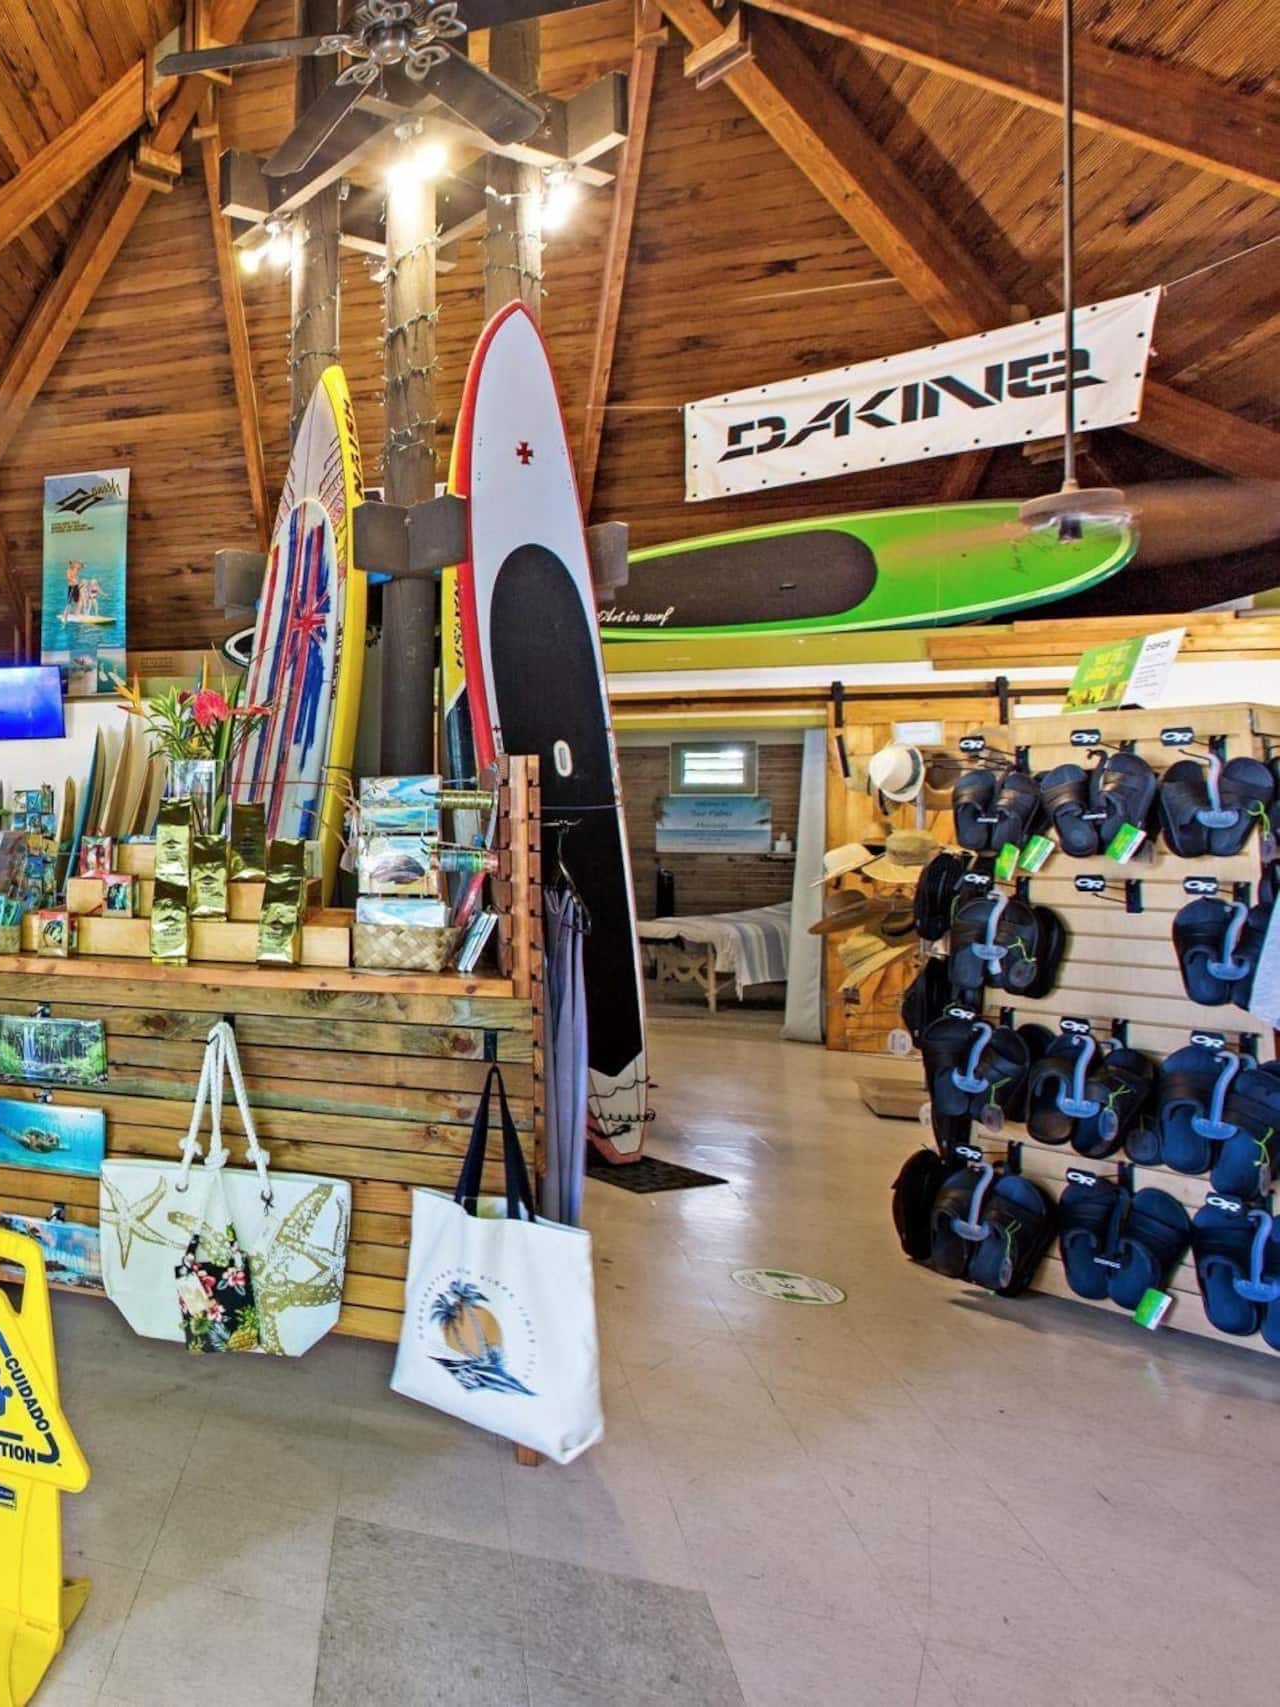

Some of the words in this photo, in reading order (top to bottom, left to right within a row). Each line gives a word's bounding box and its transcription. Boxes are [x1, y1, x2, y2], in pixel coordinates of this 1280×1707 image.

[718, 349, 1107, 463] DAKINE
[626, 610, 640, 622] in
[5, 1358, 50, 1431] CUIDADO
